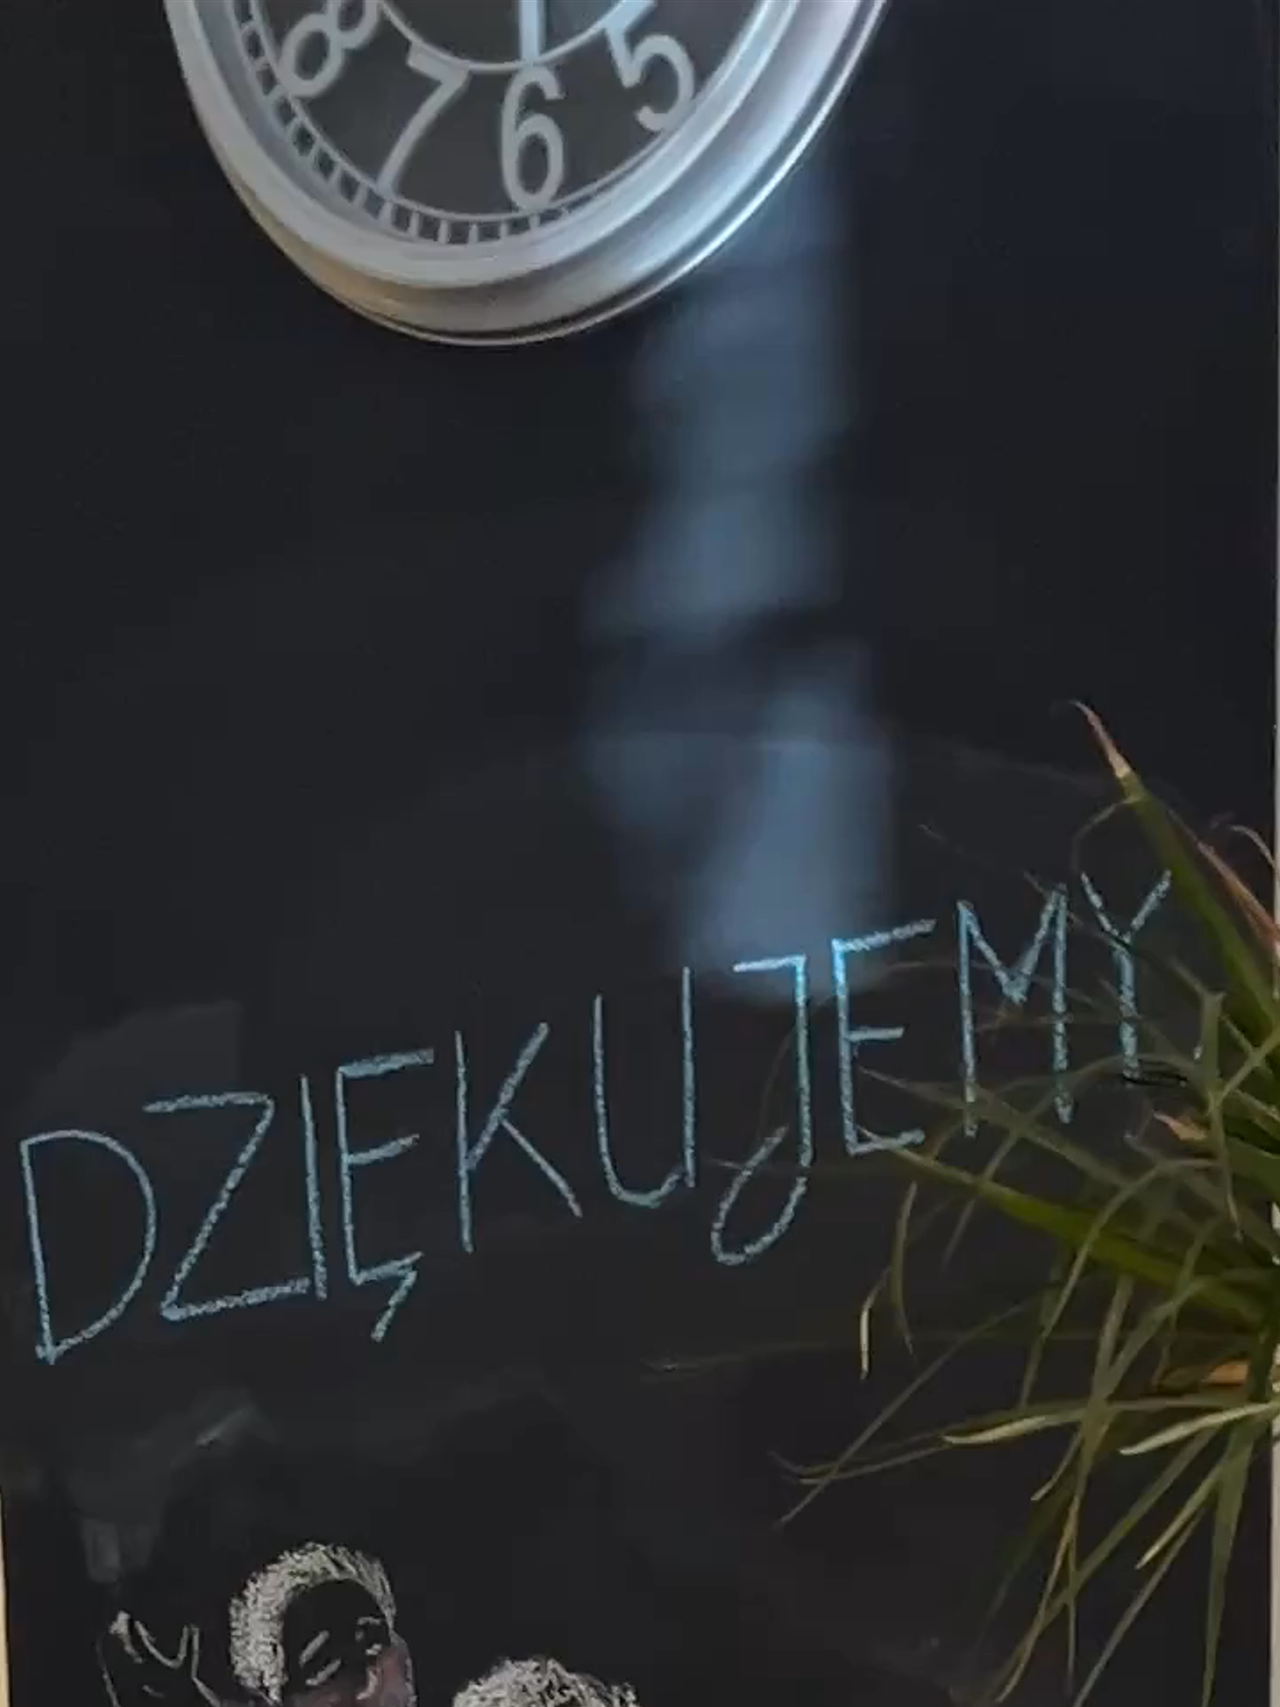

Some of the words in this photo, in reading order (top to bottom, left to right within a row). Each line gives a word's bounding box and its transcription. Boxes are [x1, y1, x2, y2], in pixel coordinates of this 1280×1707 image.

[377, 42, 471, 194] 7
[501, 60, 566, 210] 6
[605, 0, 698, 134] 5
[19, 869, 1172, 1364] DZIĘKUJEMY
